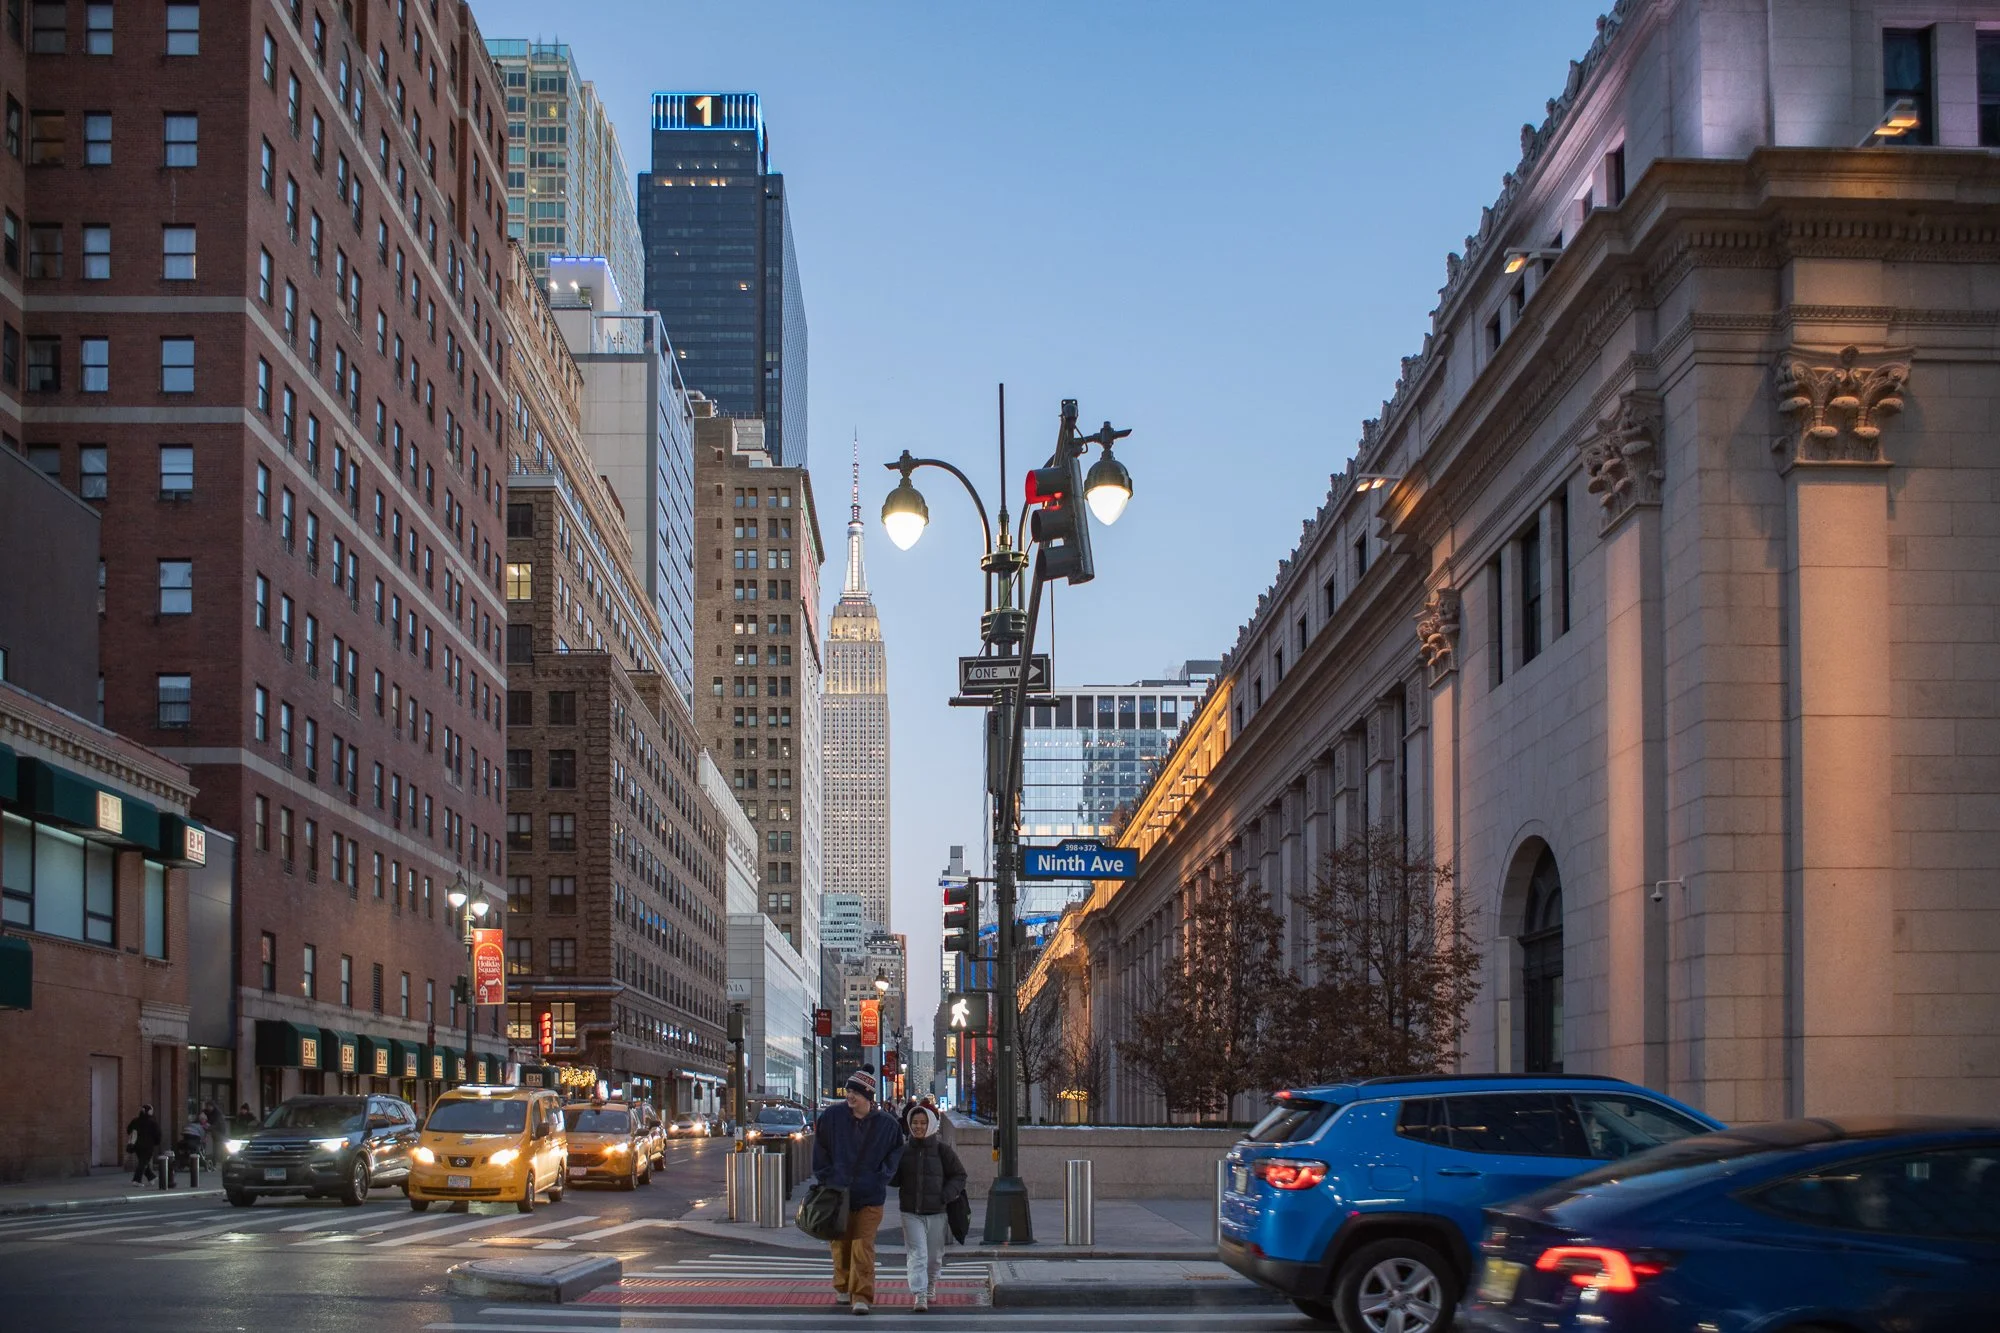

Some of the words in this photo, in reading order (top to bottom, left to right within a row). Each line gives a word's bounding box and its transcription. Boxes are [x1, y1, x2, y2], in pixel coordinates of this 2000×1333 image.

[694, 96, 712, 126] 1
[975, 667, 998, 679] ONE
[1064, 844, 1079, 852] 398
[1084, 844, 1097, 852] 372
[1038, 854, 1085, 872] Ninth
[1090, 855, 1124, 872] Ave
[477, 960, 501, 968] Holiday
[478, 966, 500, 974] Square
[543, 1012, 552, 1055] PRIMI
